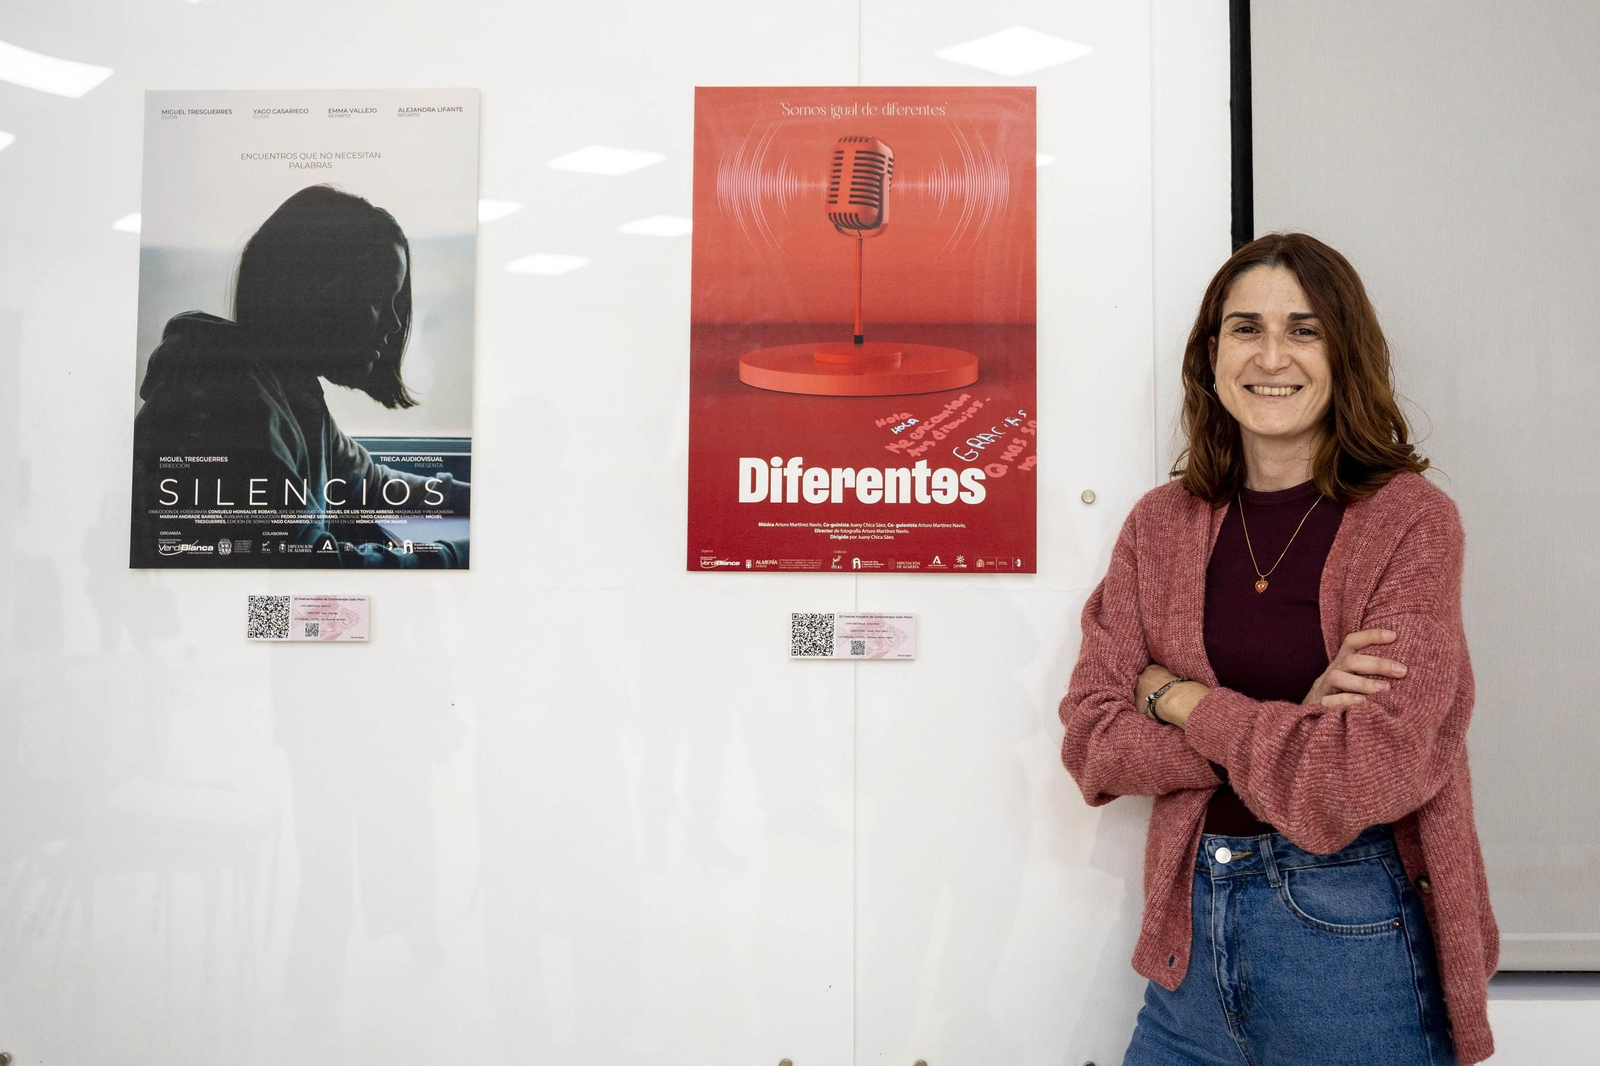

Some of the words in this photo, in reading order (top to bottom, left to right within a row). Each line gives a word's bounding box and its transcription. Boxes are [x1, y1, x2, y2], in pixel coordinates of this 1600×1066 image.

[830, 102, 858, 119] igual
[861, 102, 878, 116] de
[240, 152, 298, 160] ENCUENTROS
[299, 152, 318, 160] QUE
[335, 151, 381, 159] NECESITAN
[288, 161, 333, 169] PALABRAS
[874, 412, 913, 428] Hola
[159, 478, 444, 506] SILENCIOS
